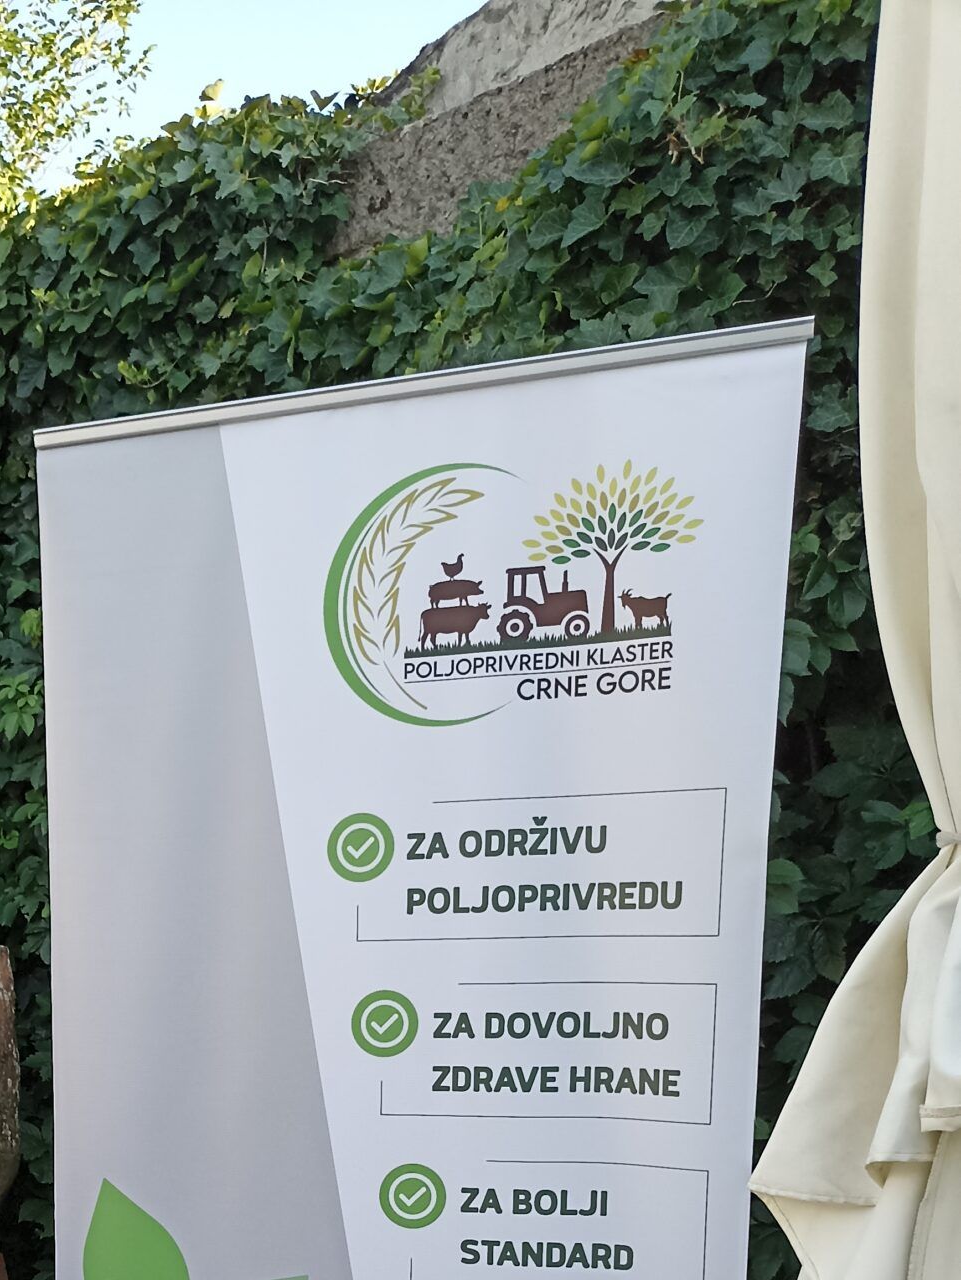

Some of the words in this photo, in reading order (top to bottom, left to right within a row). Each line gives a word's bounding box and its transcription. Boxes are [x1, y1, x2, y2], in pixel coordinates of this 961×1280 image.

[403, 654, 580, 680] POLJOPRIVREDNI
[586, 640, 674, 666] KLASTER
[516, 675, 588, 700] CRNE
[595, 667, 672, 696] GORE
[406, 832, 449, 860] ZA
[458, 816, 608, 857] ODRŽIVU
[406, 881, 683, 915] POLJOPRIVREDU
[432, 1012, 474, 1039] ZA
[484, 1012, 669, 1041] DOVOLJNO
[431, 1065, 560, 1093] ZDRAVE
[568, 1066, 681, 1097] HRANE
[460, 1187, 502, 1214] ZA
[511, 1189, 608, 1217] BOLJI
[460, 1239, 634, 1270] STANDARD
